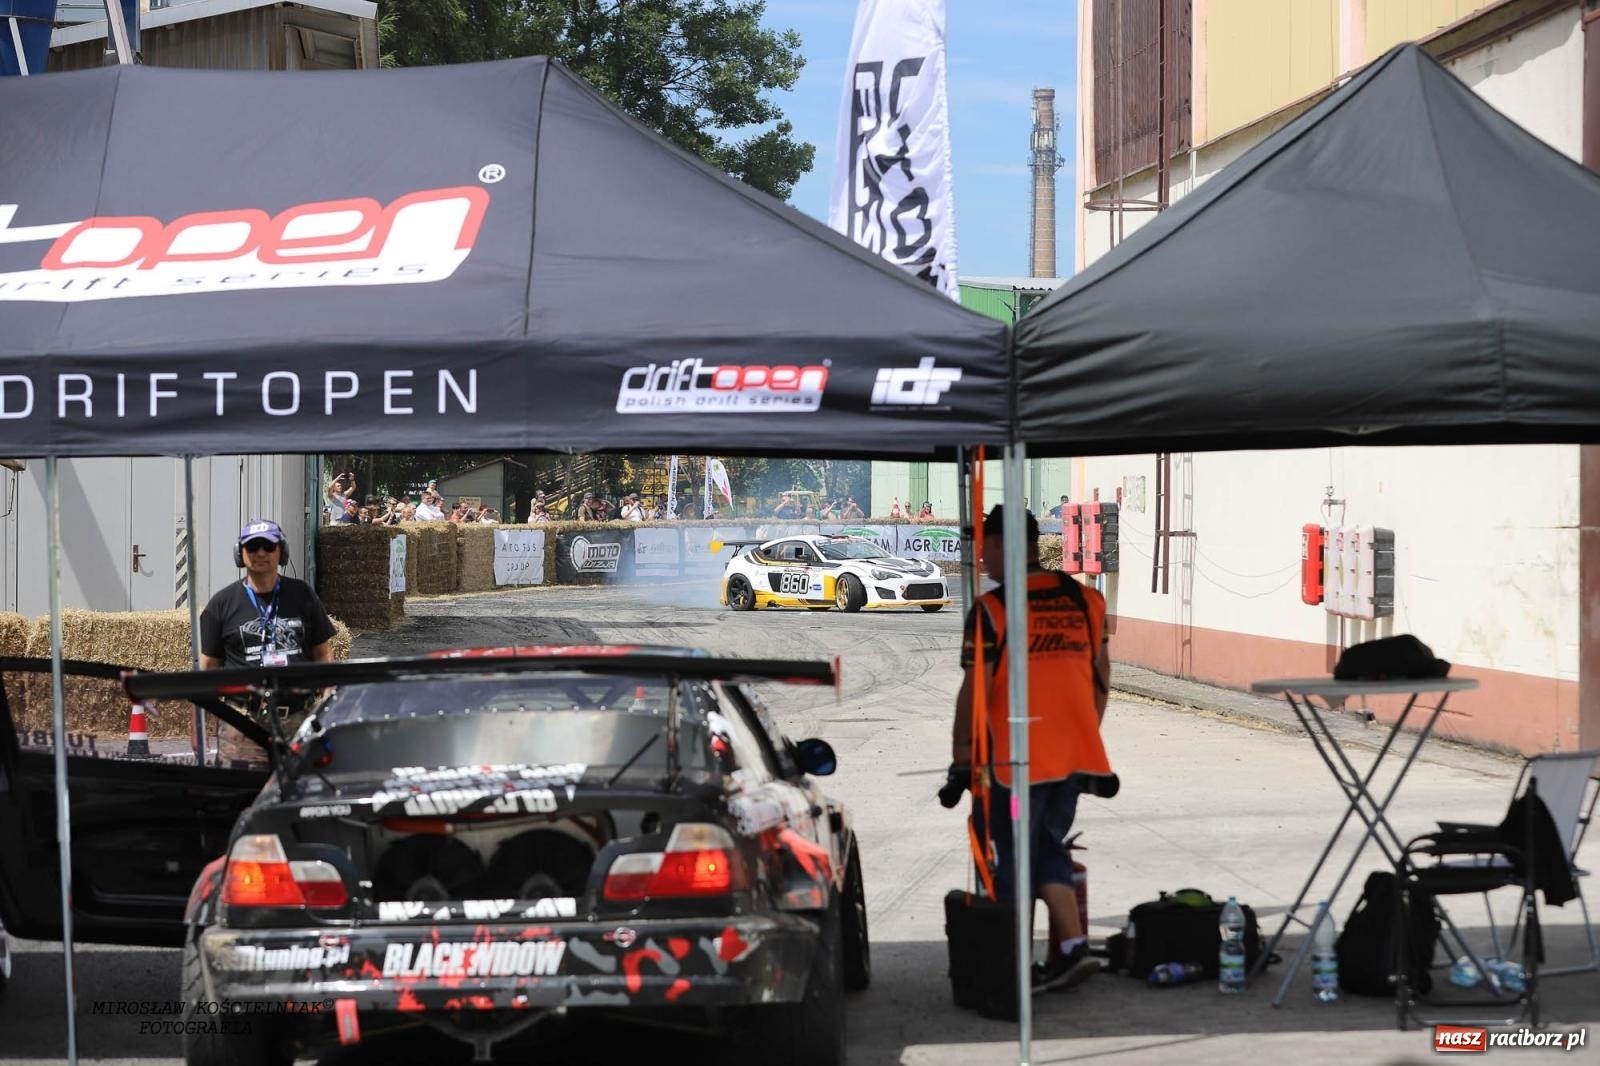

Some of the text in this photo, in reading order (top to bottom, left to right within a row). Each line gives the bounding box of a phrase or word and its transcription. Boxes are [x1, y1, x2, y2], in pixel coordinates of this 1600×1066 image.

[0, 369, 477, 419] DRIFTOPEN
[625, 393, 813, 408] polish drift series
[588, 546, 619, 559] MOTO
[582, 560, 616, 569] WIZJA
[780, 573, 810, 594] 860
[383, 941, 567, 977] BLACK WIDOW
